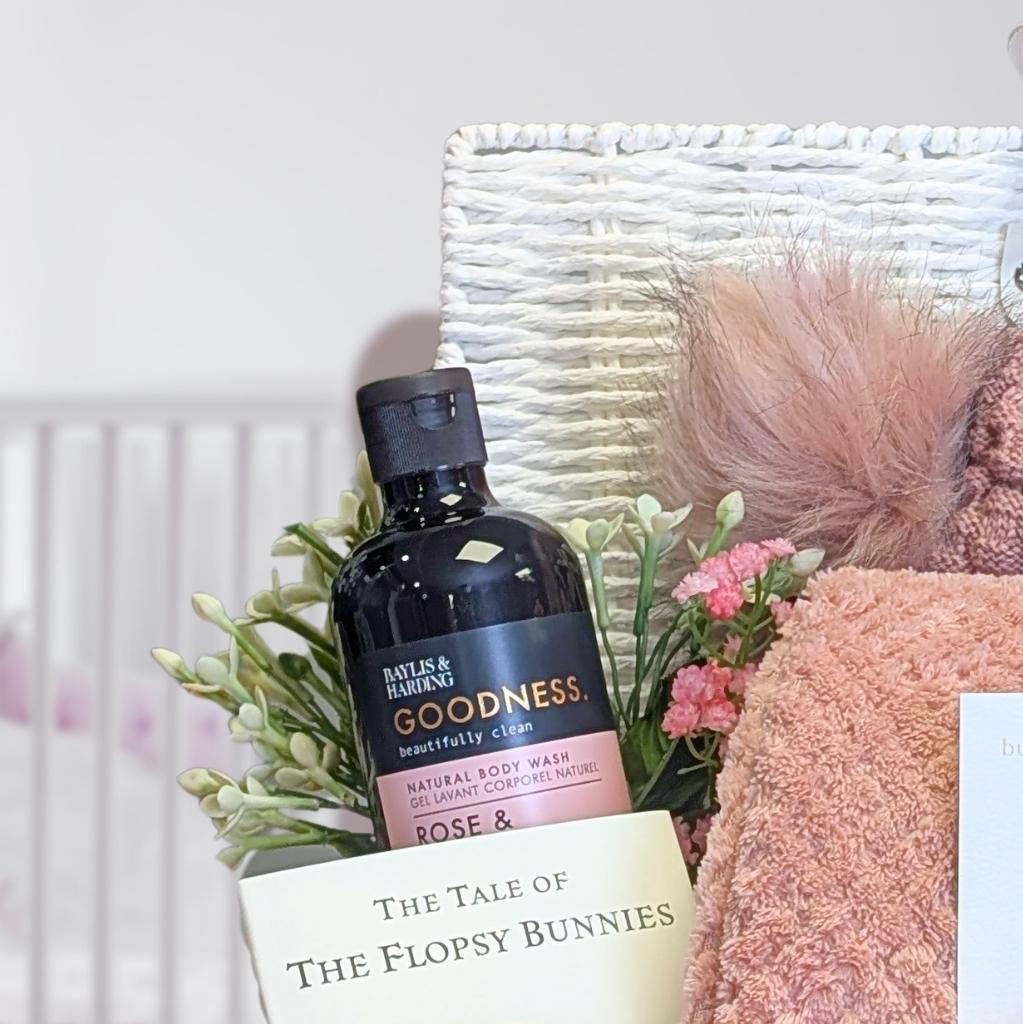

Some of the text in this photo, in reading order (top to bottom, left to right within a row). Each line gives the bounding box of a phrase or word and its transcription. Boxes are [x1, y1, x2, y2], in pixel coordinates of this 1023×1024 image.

[383, 655, 451, 684] BAYLIS &
[386, 672, 454, 700] HARDING
[399, 721, 533, 758] beautifully clean
[407, 751, 570, 795] NATURAL BODY WASH
[410, 761, 600, 809] GEL LAVANT CORPOREL NATUREL
[416, 809, 515, 845] ROSE &
[373, 892, 440, 921] THE
[532, 871, 569, 895] OF
[286, 953, 370, 990] THE
